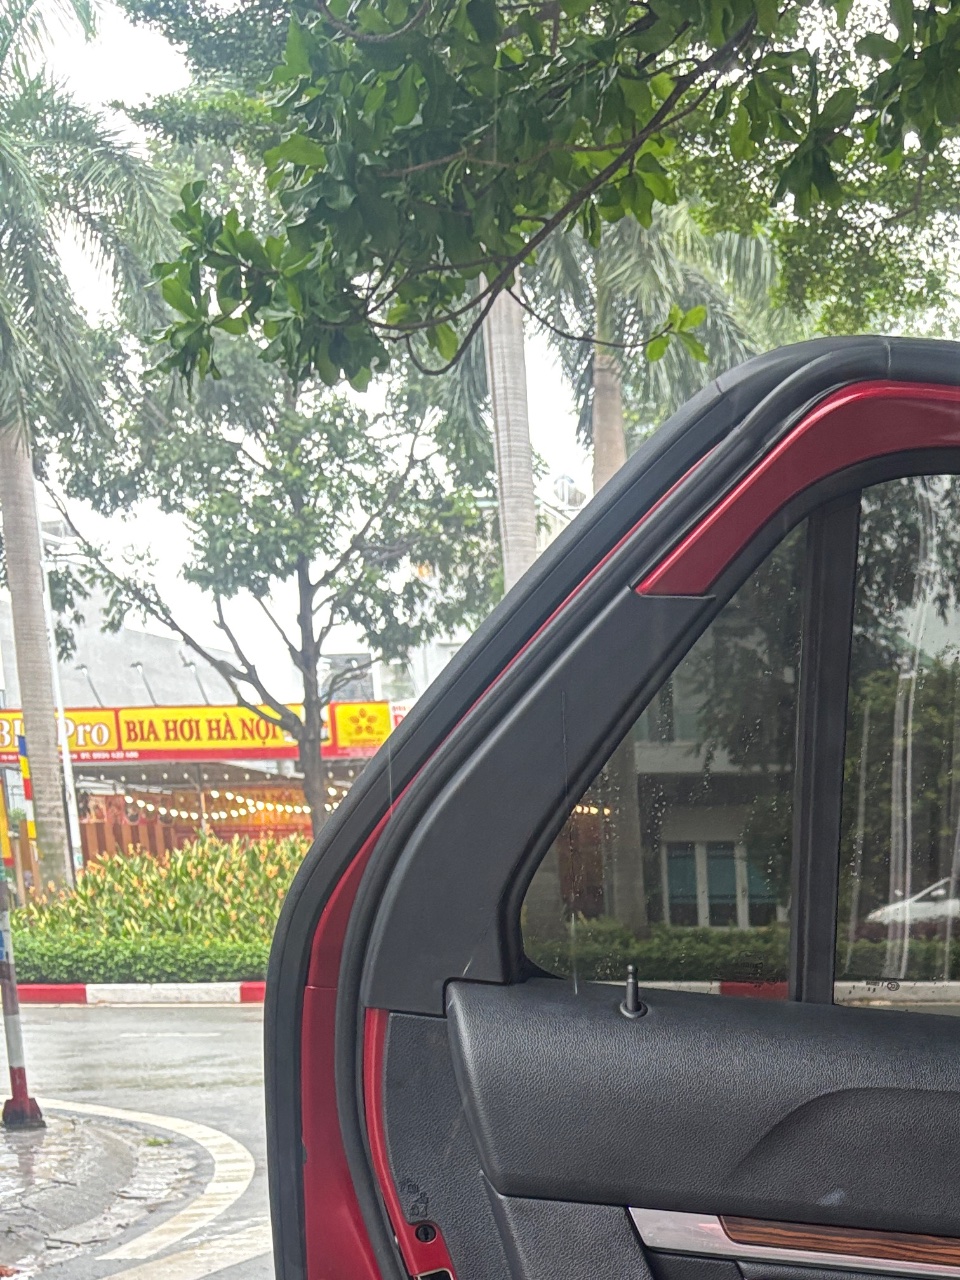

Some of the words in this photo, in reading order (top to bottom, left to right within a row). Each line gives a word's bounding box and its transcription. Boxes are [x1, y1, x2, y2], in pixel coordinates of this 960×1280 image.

[56, 718, 110, 747] Pro
[125, 719, 160, 742] BIA
[163, 717, 202, 742] HƠI
[206, 712, 237, 741] HÀ
